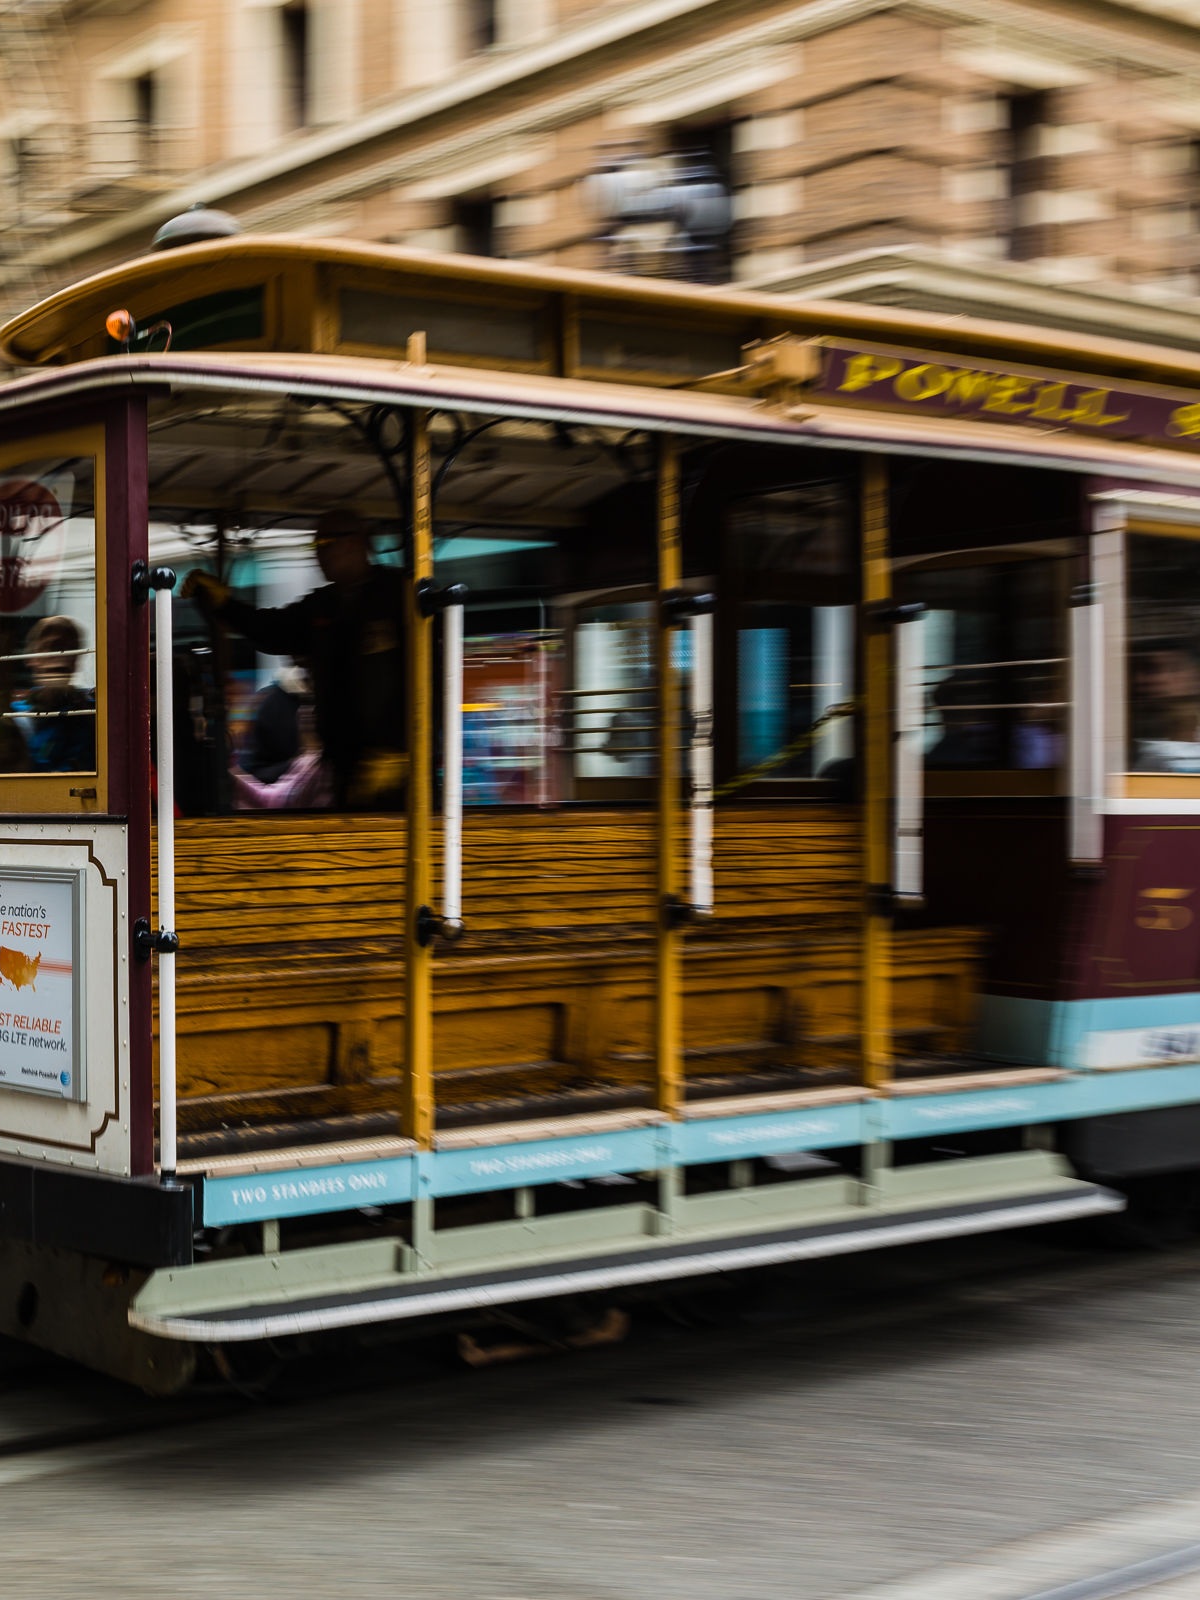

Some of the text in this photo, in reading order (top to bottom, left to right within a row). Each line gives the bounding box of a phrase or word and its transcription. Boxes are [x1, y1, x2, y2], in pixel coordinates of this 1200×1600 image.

[836, 353, 1133, 427] POWELL
[8, 903, 46, 919] nation's
[1135, 887, 1197, 931] 5
[1, 921, 51, 939] FASTEST
[13, 1014, 62, 1035] RELIABLE
[11, 1031, 28, 1046] LTE
[28, 1036, 67, 1052] network.
[231, 1171, 388, 1206] TWO STANDEES ONLY
